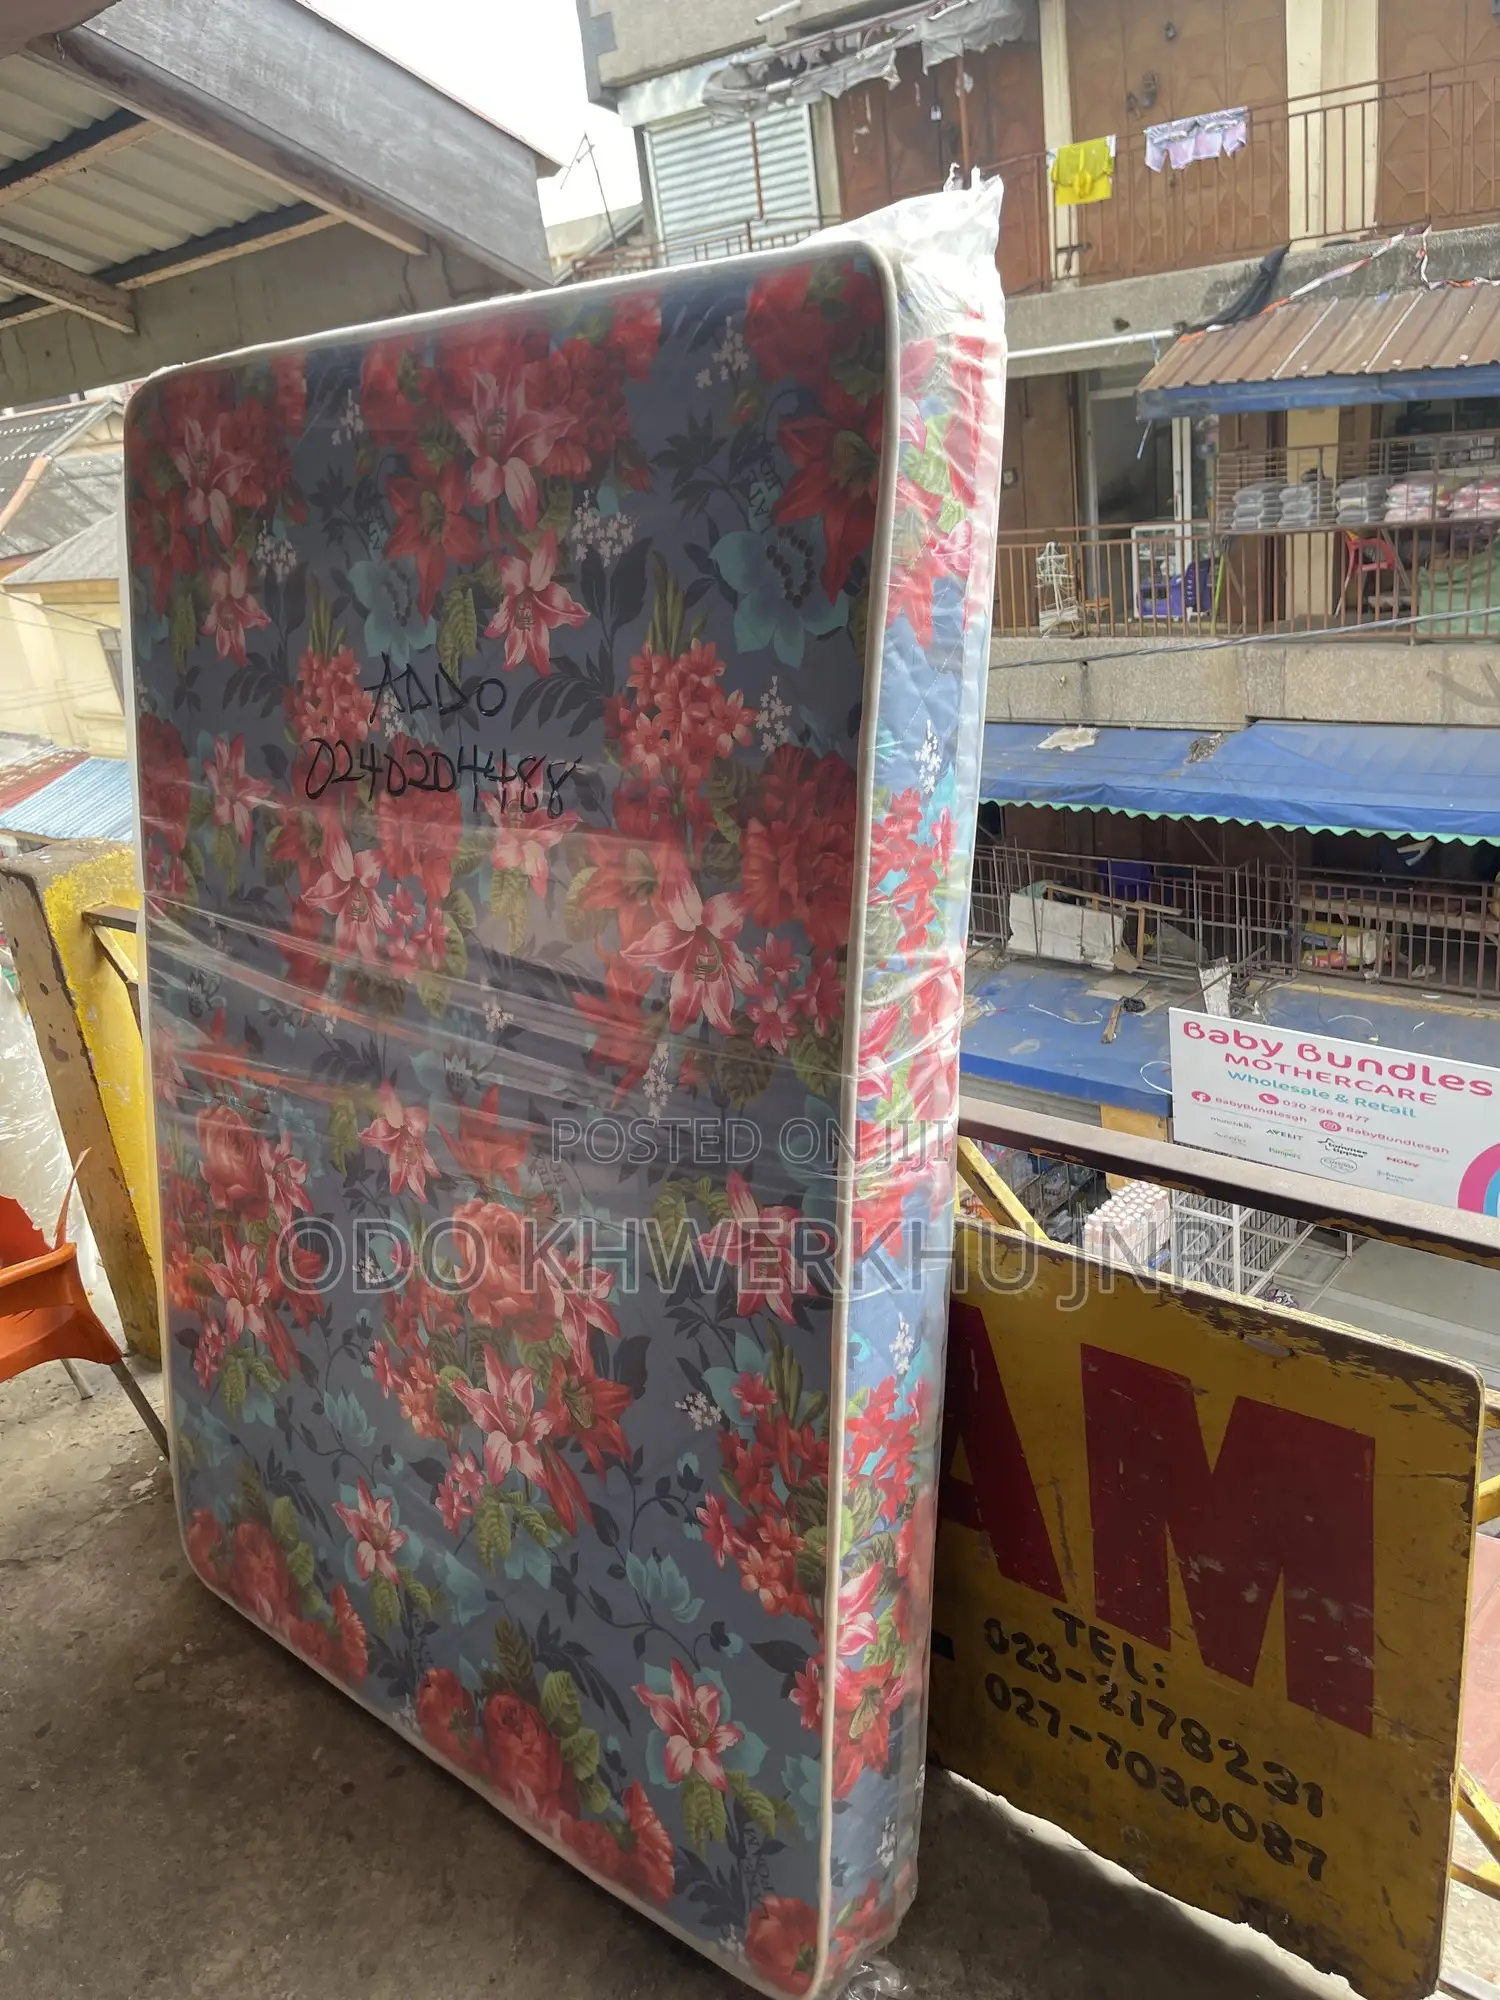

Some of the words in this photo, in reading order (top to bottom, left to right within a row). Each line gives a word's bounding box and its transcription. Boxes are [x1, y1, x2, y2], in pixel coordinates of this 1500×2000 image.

[364, 651, 507, 724] ADDO
[1183, 1021, 1283, 1057] Baby
[1297, 1043, 1493, 1097] Bundles
[1224, 1052, 1437, 1106] MOTHERCARE
[1215, 1097, 1307, 1123] BabyBundlesgh
[1227, 1070, 1330, 1100] Wholesale
[1335, 1093, 1349, 1104] &
[1354, 1097, 1417, 1118] Retail
[1282, 1099, 1307, 1110] 030
[1310, 1105, 1334, 1116] 266
[1337, 1111, 1370, 1123] 8477
[1346, 1126, 1450, 1154] BabyBundlesgh
[1052, 1607, 1166, 1689] TEL:
[984, 1617, 1324, 1818] 023-2178231
[985, 1673, 1328, 1881] 027-7030087
